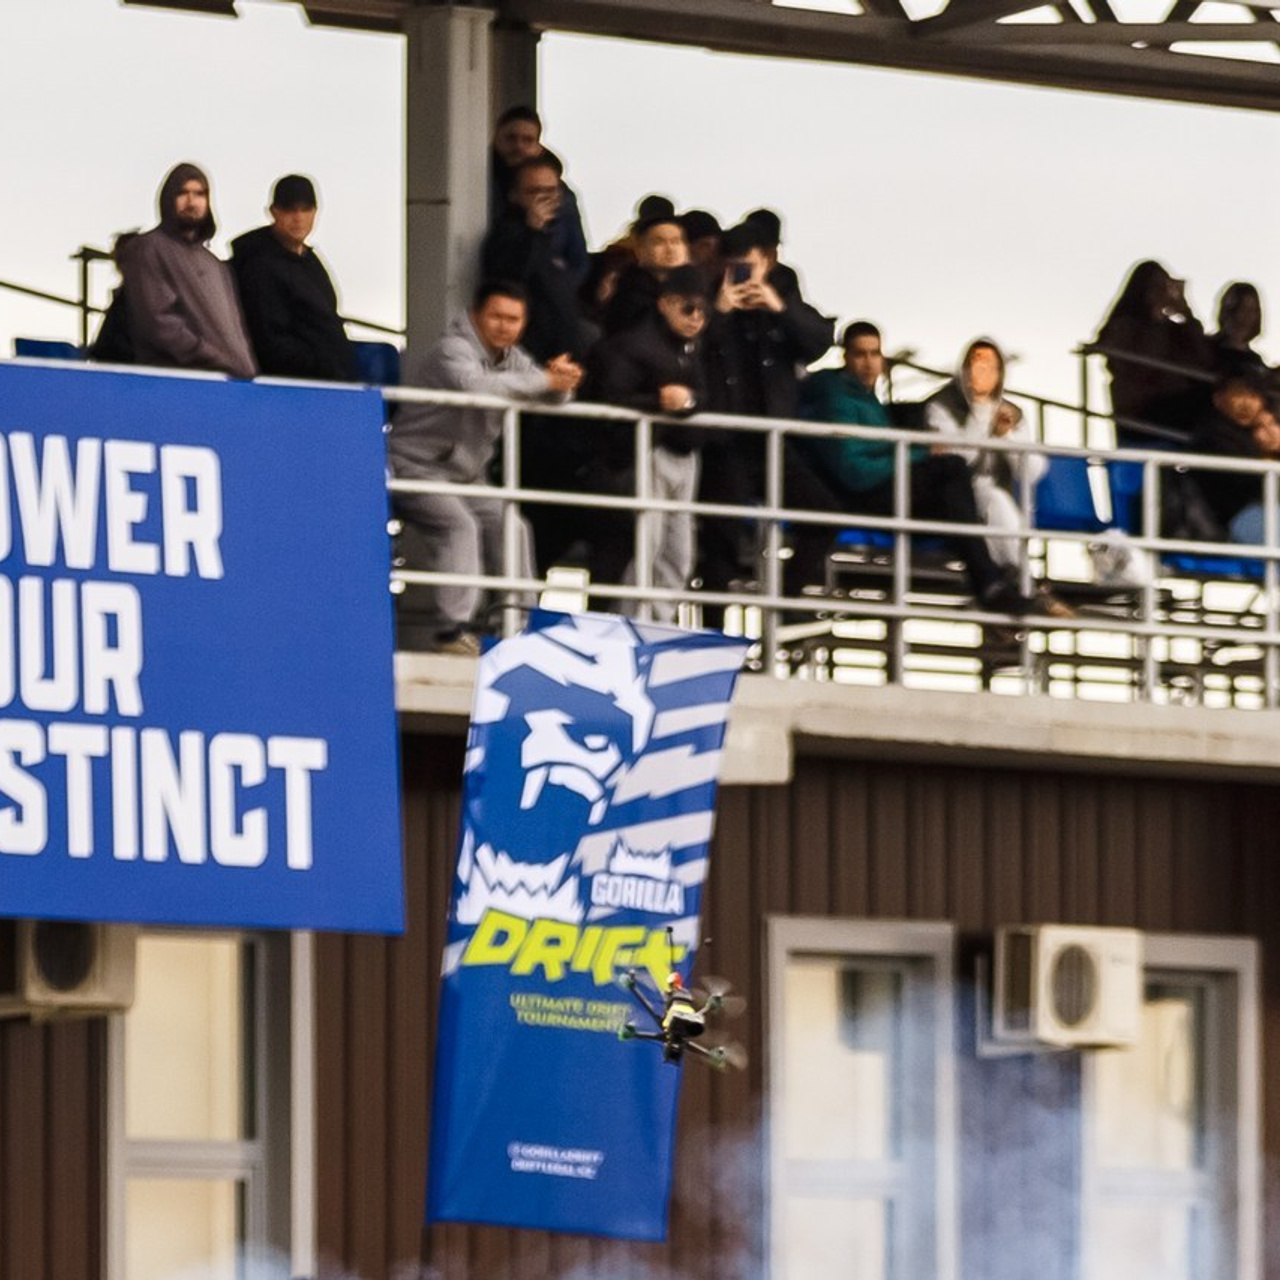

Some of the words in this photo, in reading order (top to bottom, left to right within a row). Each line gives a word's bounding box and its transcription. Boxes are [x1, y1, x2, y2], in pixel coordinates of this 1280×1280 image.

[0, 431, 225, 580] WER
[0, 573, 144, 717] UR
[0, 717, 329, 871] STINCT
[462, 906, 687, 994] DRIFT
[591, 873, 685, 914] GORILLA
[510, 992, 584, 1015] ULTIMATE
